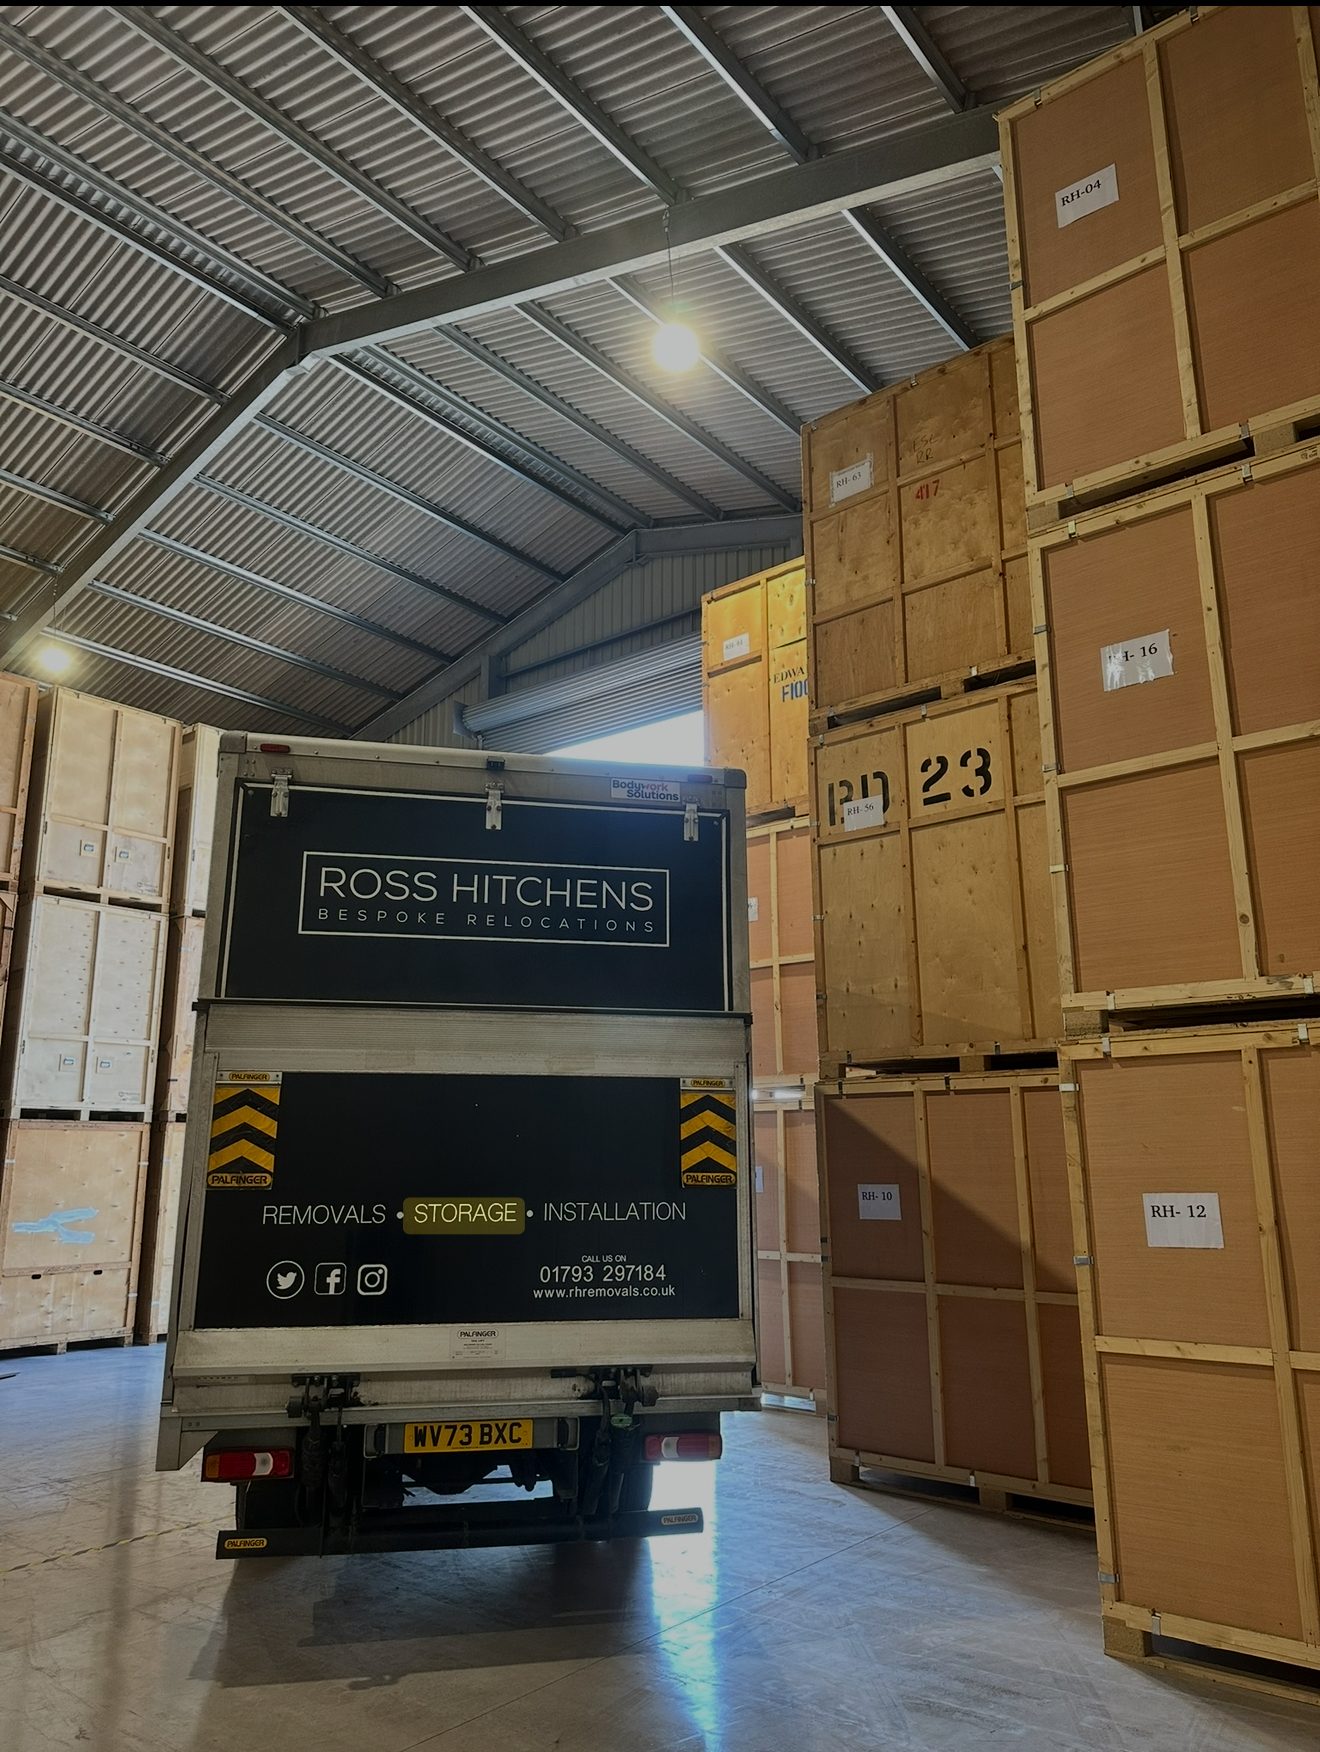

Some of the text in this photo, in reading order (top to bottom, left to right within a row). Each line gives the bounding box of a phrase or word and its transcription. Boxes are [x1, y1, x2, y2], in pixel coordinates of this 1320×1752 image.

[1061, 180, 1101, 206] RH-04
[915, 479, 940, 500] 417
[1140, 643, 1158, 657] 16
[921, 748, 992, 806] 23
[612, 780, 668, 792] Bodywork
[627, 789, 679, 800] Solutions
[319, 866, 653, 912] ROSS HITCHENS
[318, 908, 654, 933] BESPOKE RELOCATIONS
[211, 1175, 268, 1185] PALFINGER
[686, 1174, 733, 1183] PALFINGER
[862, 1191, 893, 1201] RH- 10
[262, 1201, 686, 1225] REMOVALS STORAGE INSTALLATION
[1151, 1205, 1206, 1217] RH- 12
[581, 1254, 626, 1263] CALL US ON
[539, 1264, 666, 1283] 01793 297184
[533, 1284, 676, 1298] www.rhremovals.co.uk
[414, 1422, 522, 1447] WV73 BXC
[227, 1539, 265, 1548] PALFINGER
